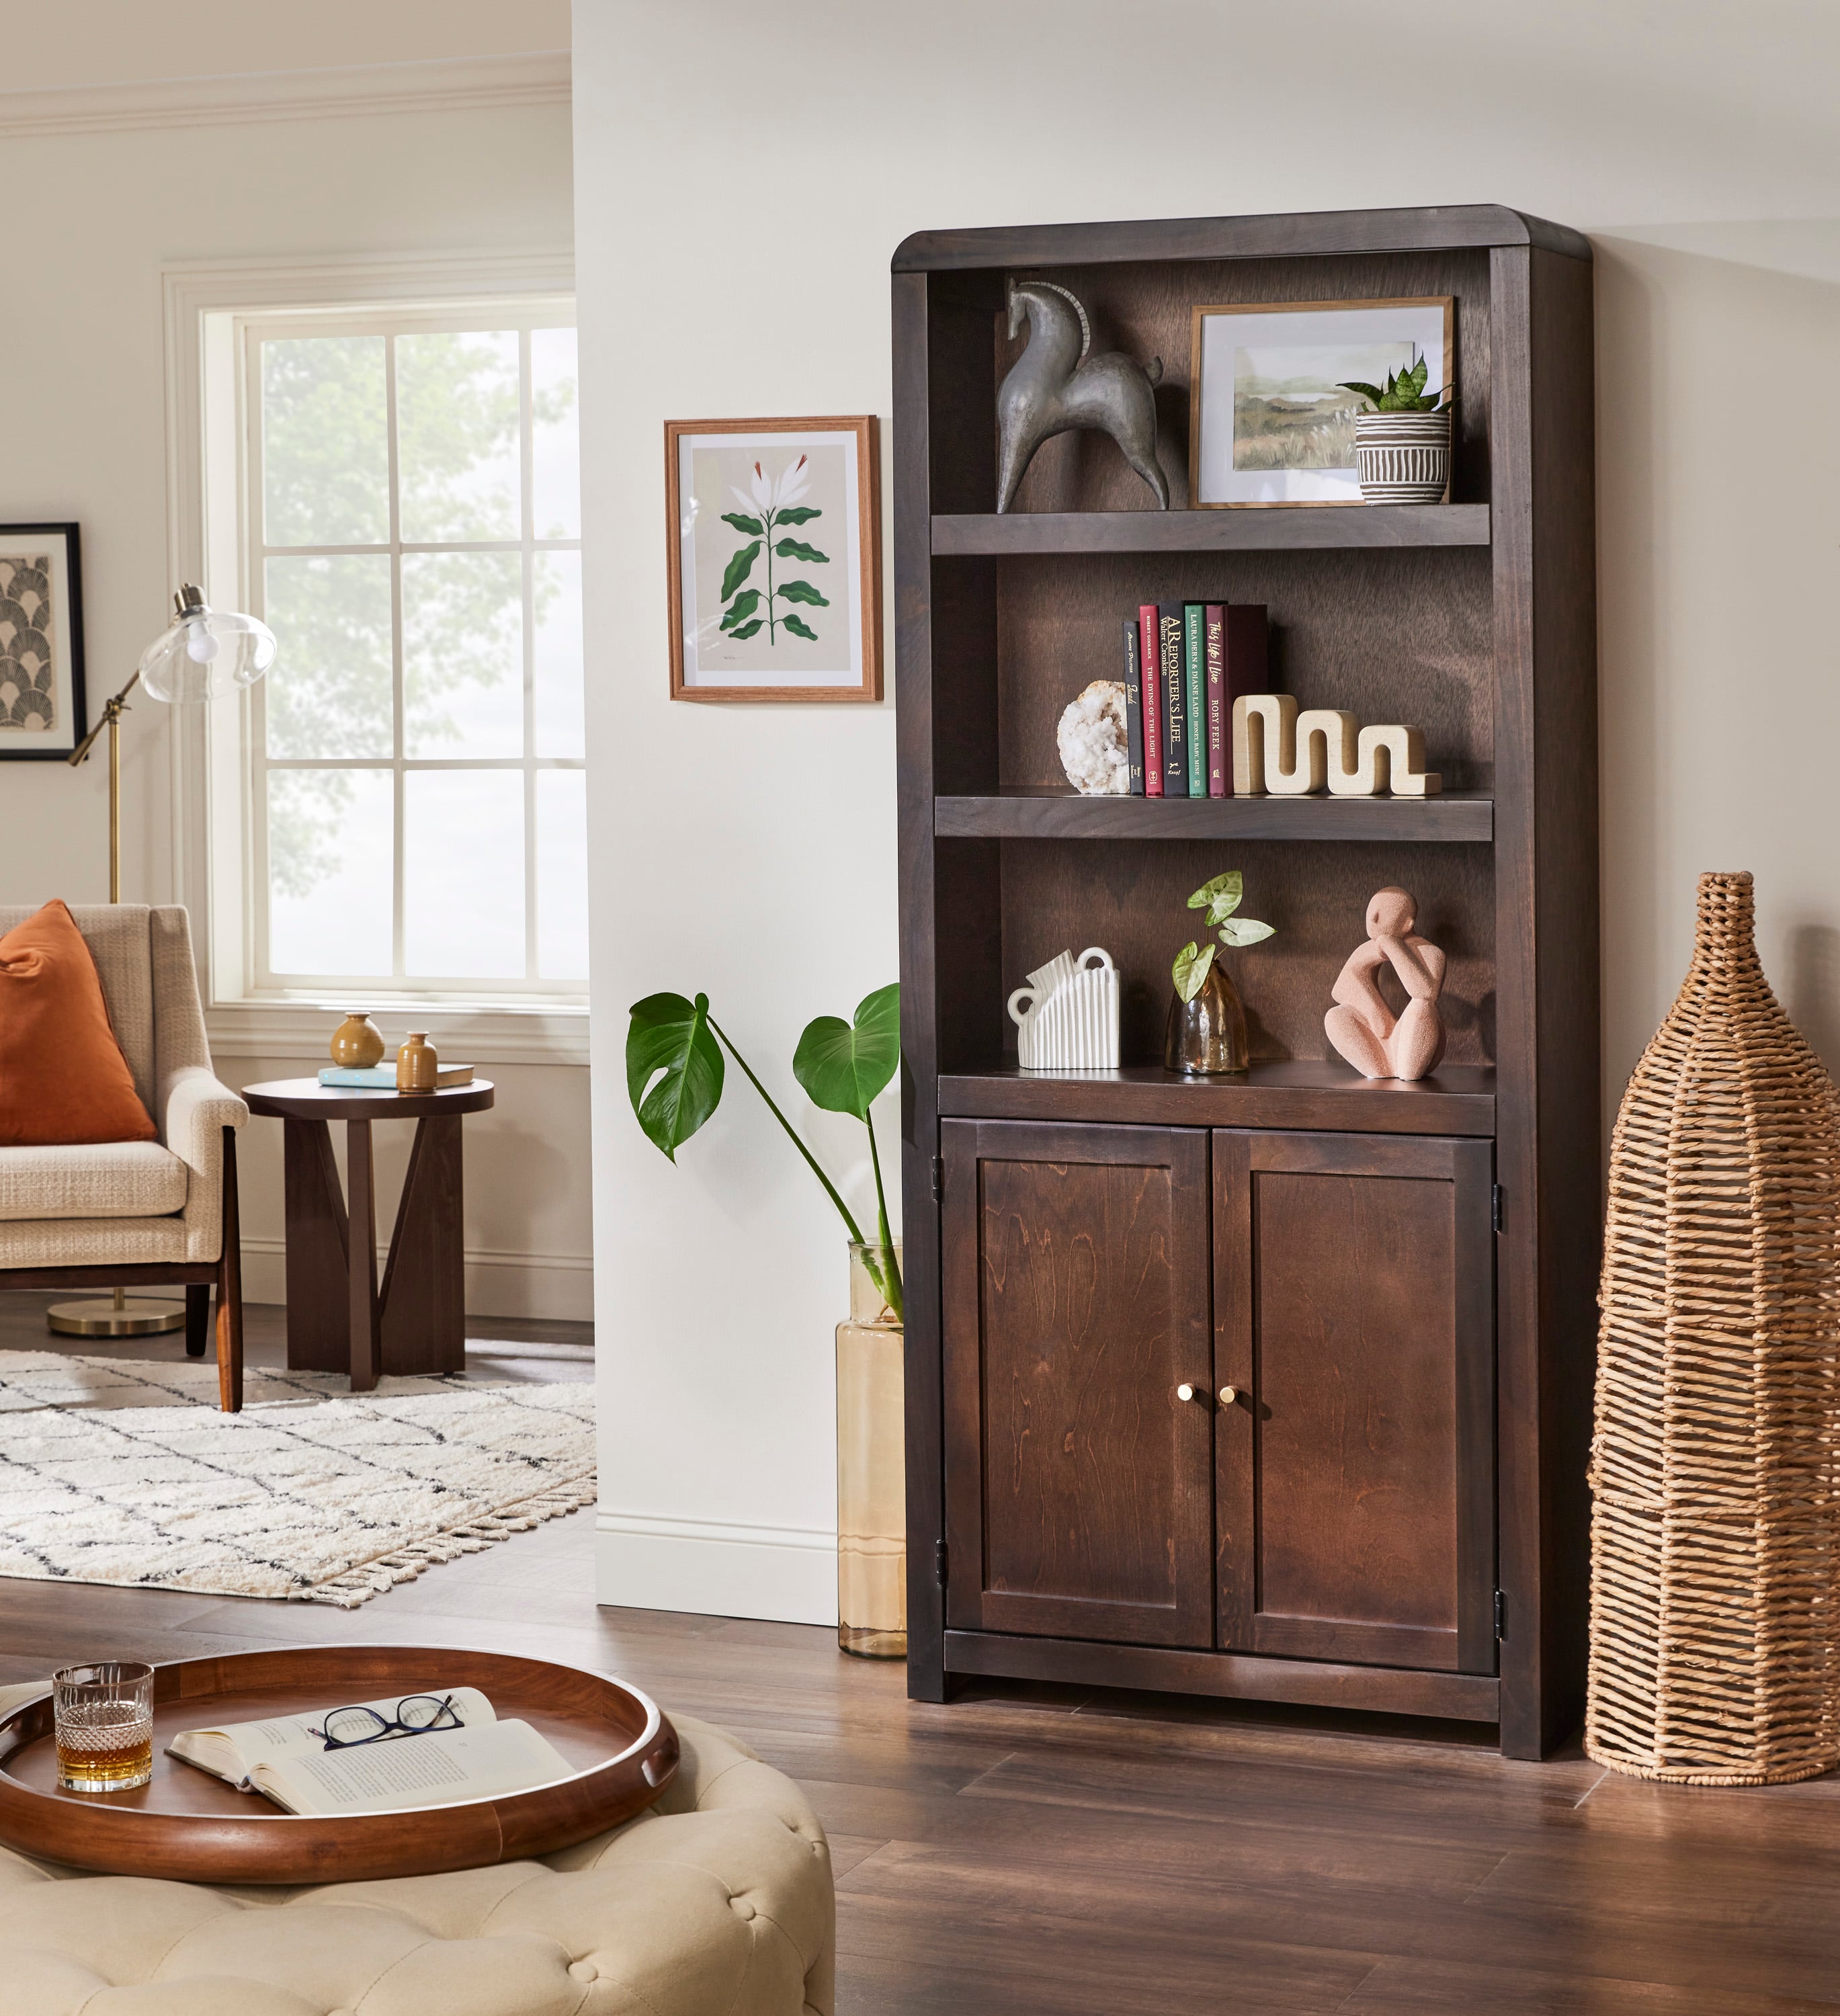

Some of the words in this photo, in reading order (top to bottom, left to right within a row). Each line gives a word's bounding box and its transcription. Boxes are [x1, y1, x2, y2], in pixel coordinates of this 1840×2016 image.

[1161, 616, 1169, 641] Walter
[1169, 617, 1181, 629] A
[1208, 622, 1221, 641] This
[1207, 642, 1221, 659] Life
[1169, 630, 1181, 713] REPORTER'S
[1209, 666, 1222, 684] Live
[1148, 707, 1155, 716] OF
[1211, 700, 1219, 724] RORY
[1171, 714, 1183, 743] LIFE
[1212, 726, 1220, 750] FEEK
